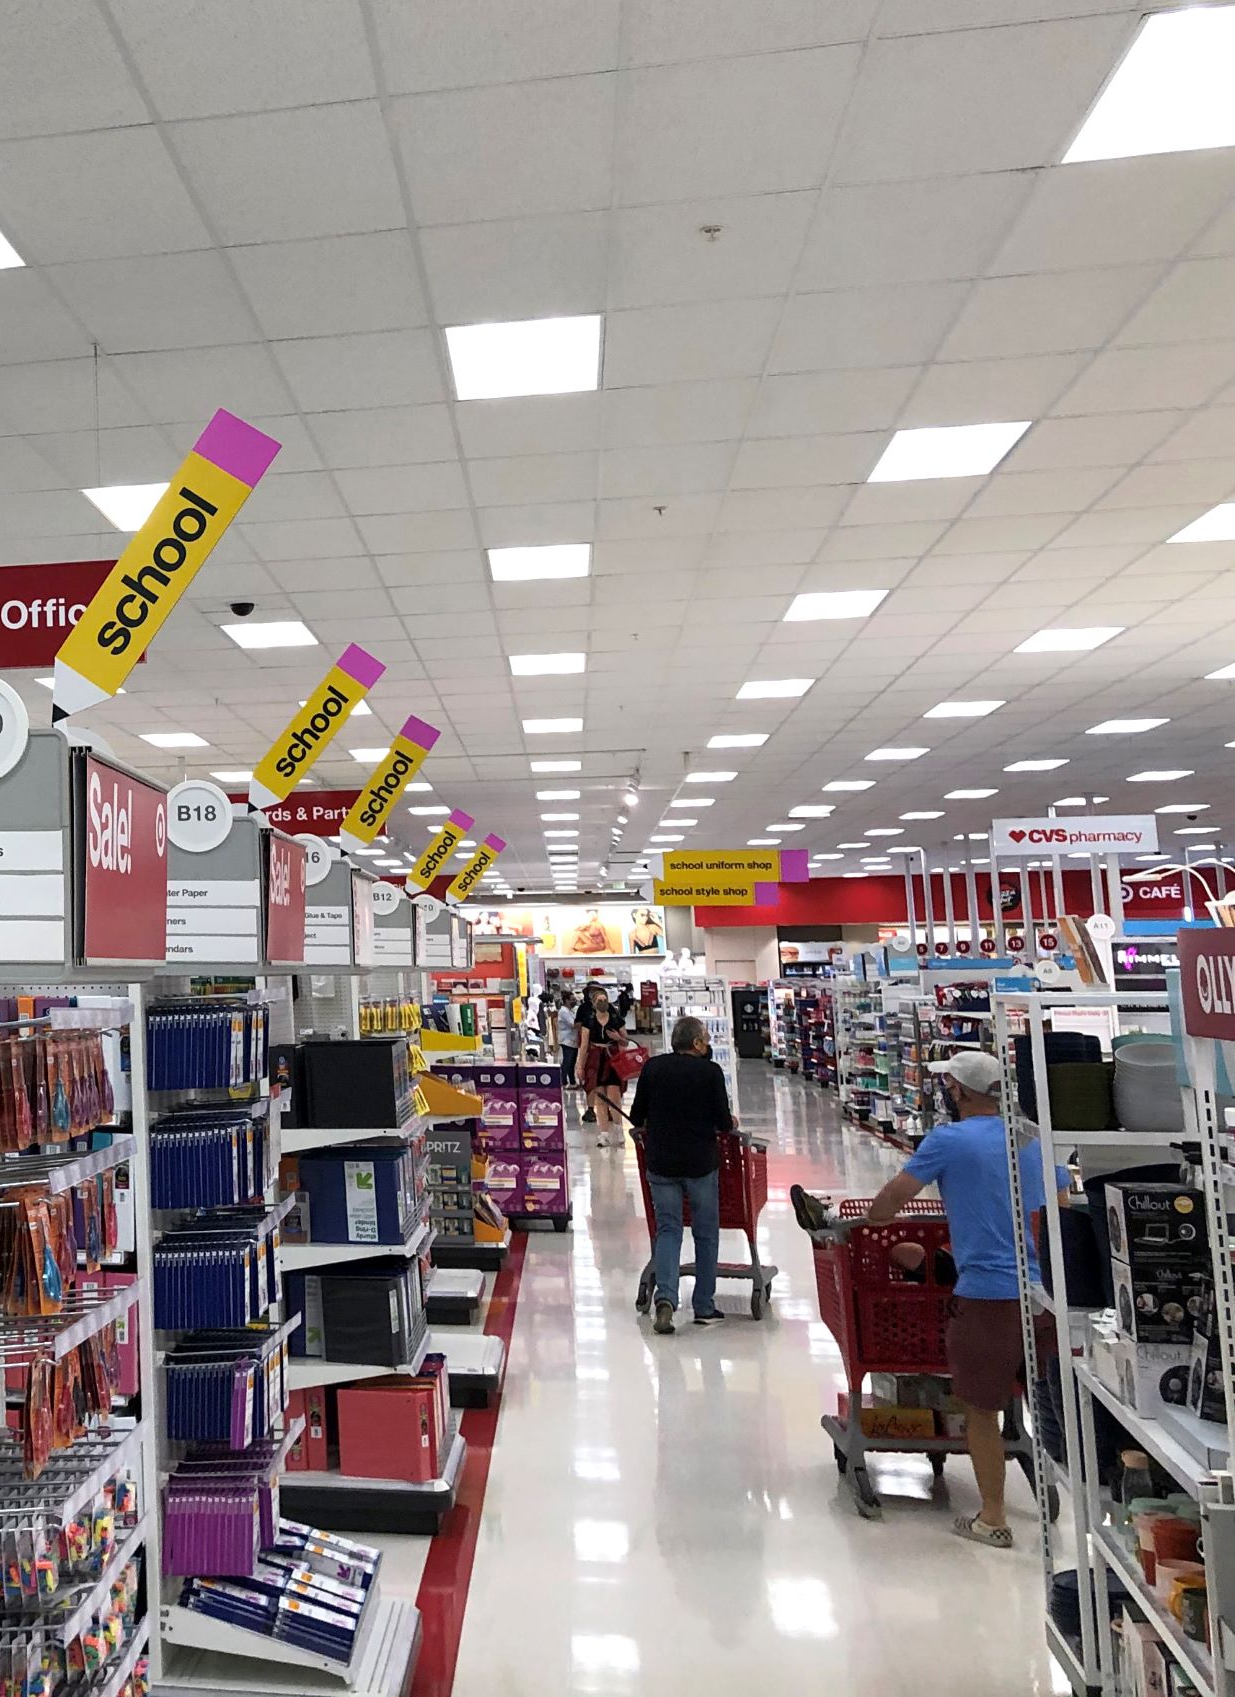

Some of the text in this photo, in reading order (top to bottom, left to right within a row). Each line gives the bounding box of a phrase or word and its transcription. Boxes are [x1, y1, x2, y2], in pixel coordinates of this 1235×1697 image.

[97, 486, 219, 656] school
[276, 685, 349, 778] school
[360, 750, 414, 827] school
[177, 804, 217, 822] B18
[296, 806, 309, 821] &
[89, 771, 133, 875] Sale!
[1028, 829, 1142, 845] CVS pharmacy
[420, 829, 457, 879] school
[270, 843, 291, 906] Sale!
[457, 851, 491, 894] school
[670, 861, 773, 871] school uniform shop
[182, 888, 208, 898] Paper
[373, 892, 392, 902] B12
[660, 887, 748, 897] school style shop
[1139, 883, 1182, 899] CAFÉ
[1127, 1195, 1171, 1211] Chillout
